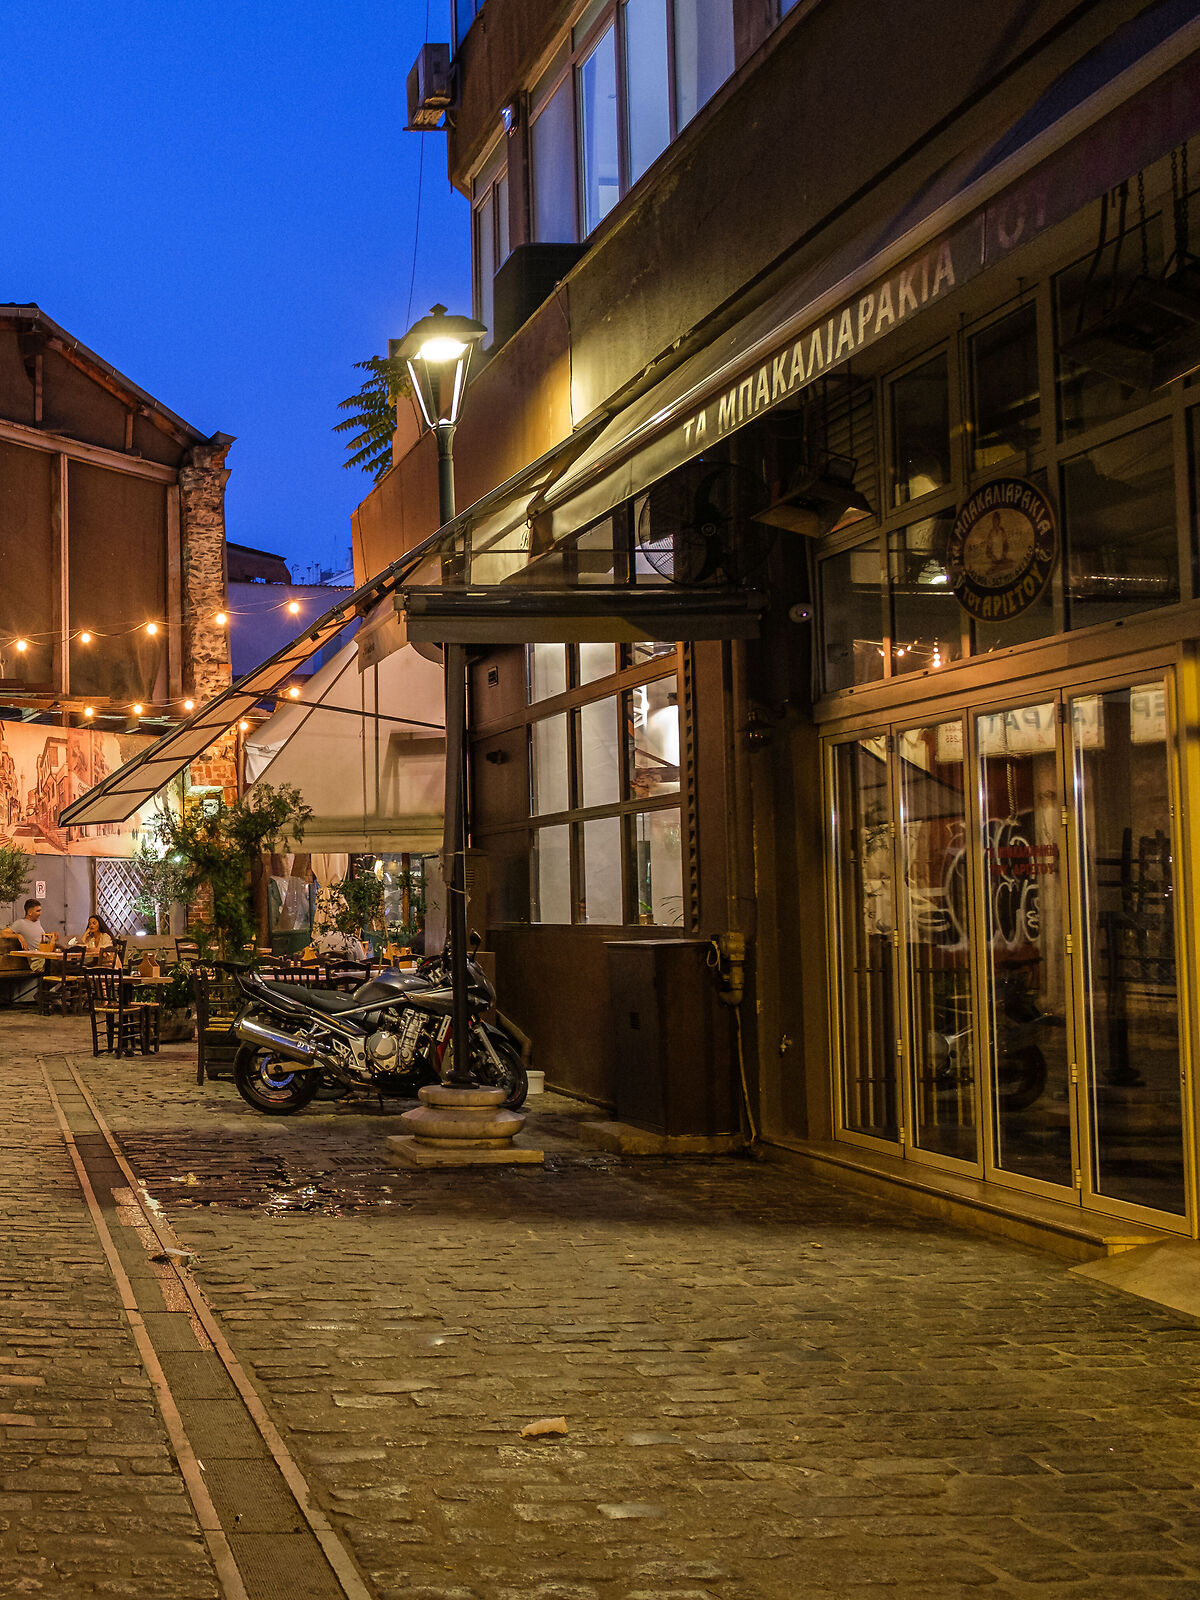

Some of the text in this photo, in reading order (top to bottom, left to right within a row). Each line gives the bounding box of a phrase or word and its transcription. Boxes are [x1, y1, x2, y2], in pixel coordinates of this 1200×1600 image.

[683, 407, 708, 446] ΤΑ
[717, 240, 956, 435] ΜΠΑΚΑΛΙΑΡΑΚΙΑ
[954, 483, 1052, 541] ΜΠΑΚΑΛΙΑΡΑΚΙΑ
[982, 561, 1044, 617] ΑΡΙΣΤΟΥ
